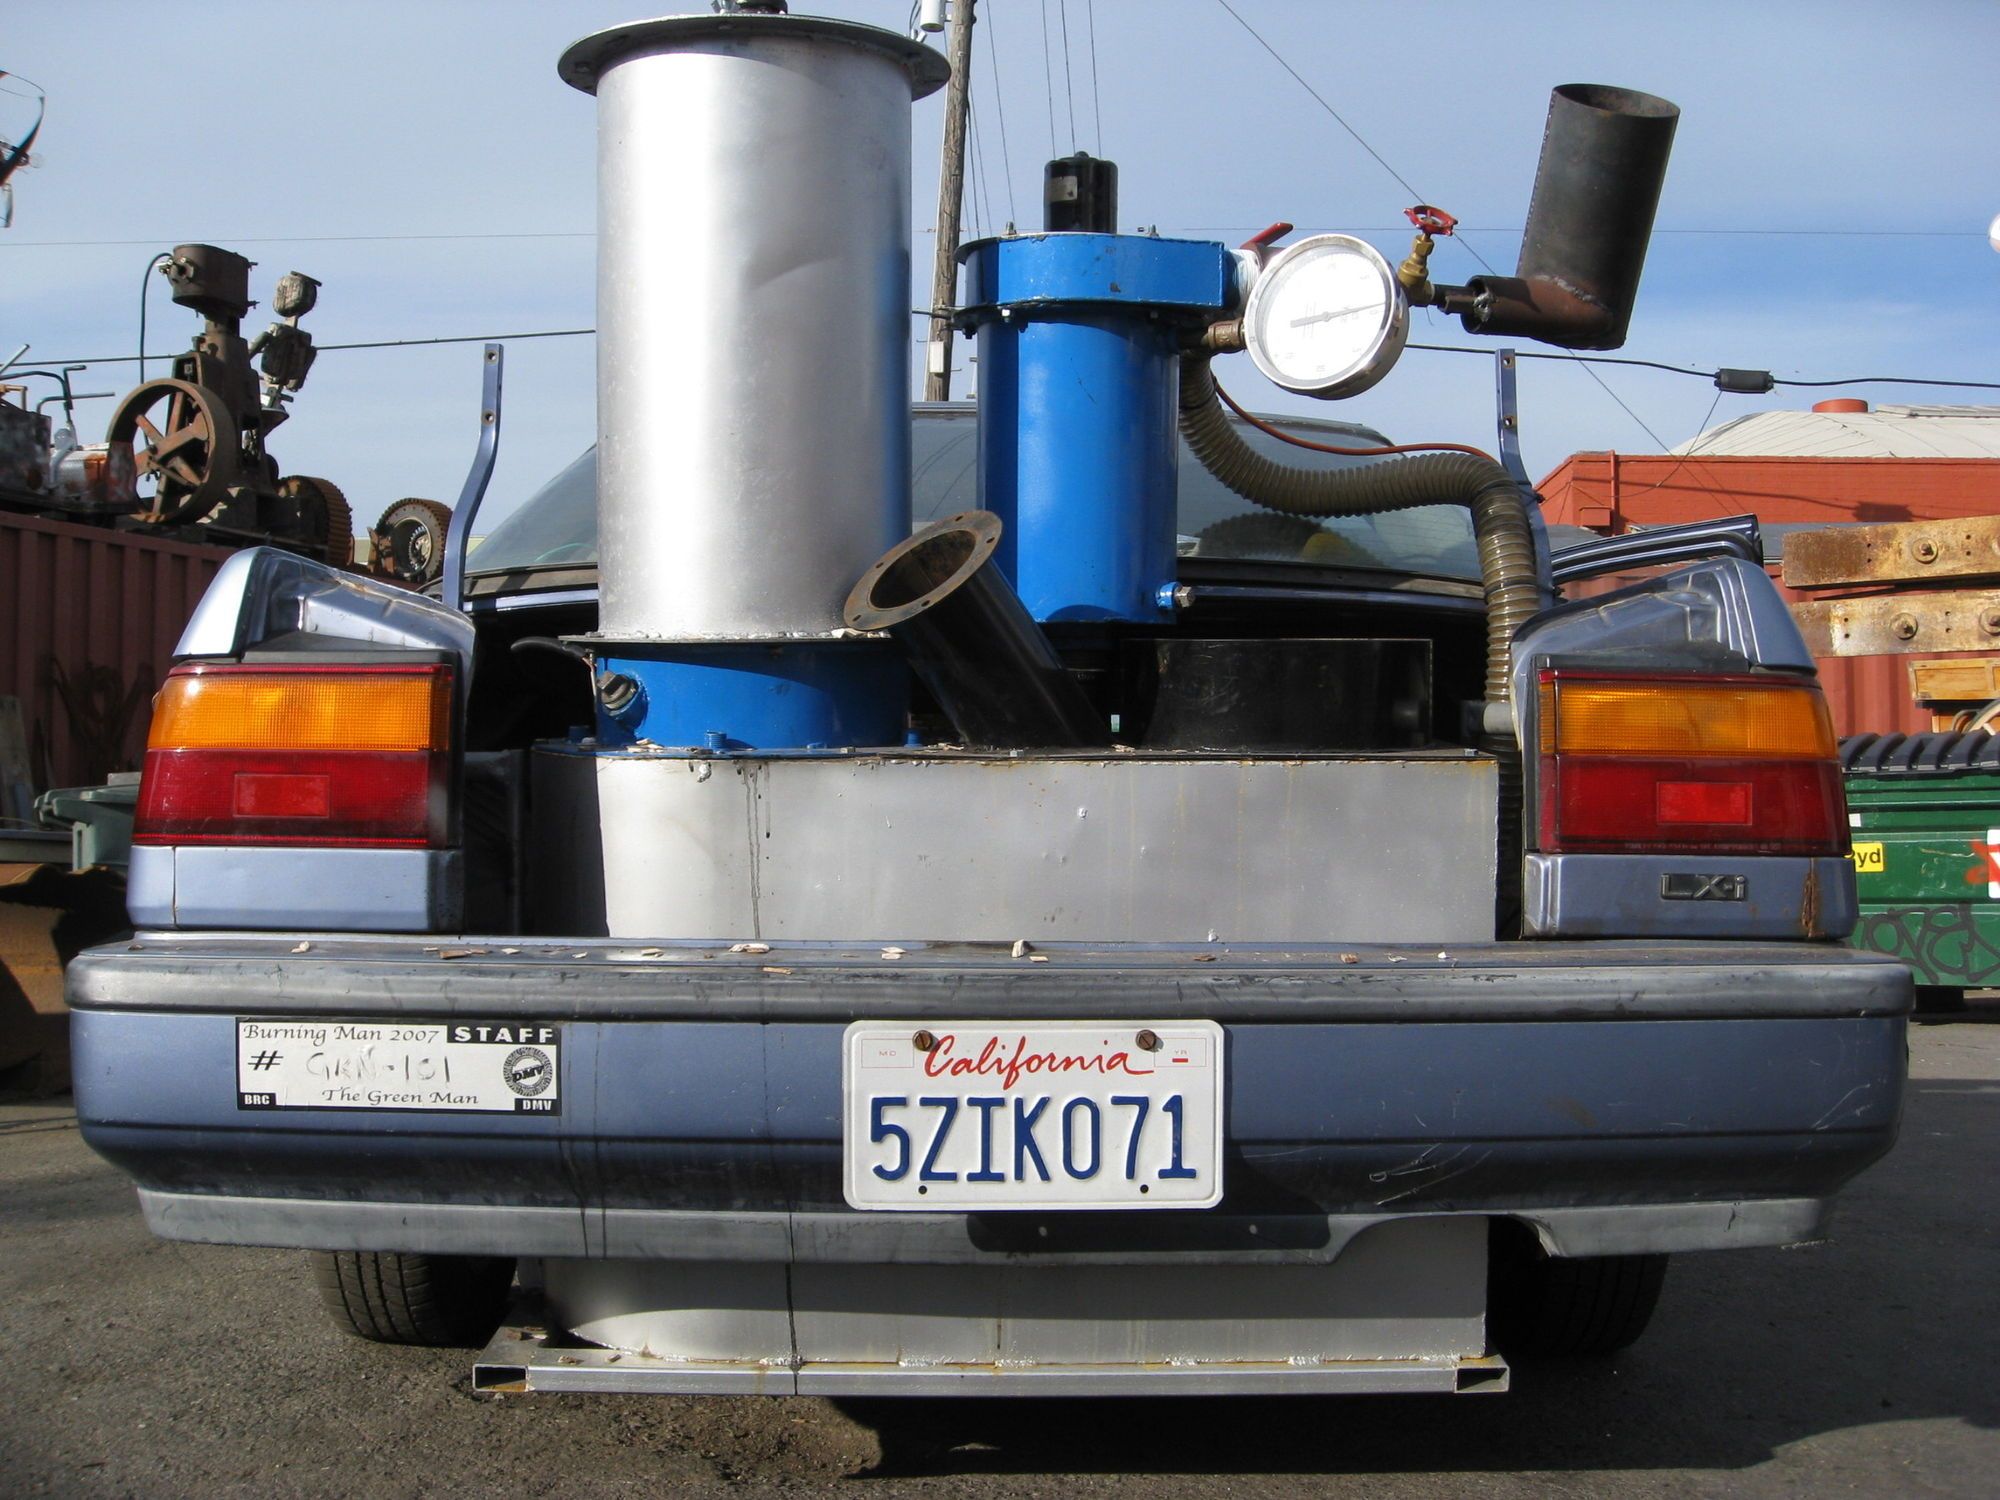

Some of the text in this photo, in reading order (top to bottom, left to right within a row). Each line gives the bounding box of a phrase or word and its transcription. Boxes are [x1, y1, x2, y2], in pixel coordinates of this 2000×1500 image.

[1660, 874, 1745, 899] LXi
[243, 1024, 440, 1047] Burning Man 2007
[454, 1026, 554, 1043] STAFF
[923, 1034, 1155, 1091] California
[512, 1064, 544, 1083] DMV
[244, 1094, 270, 1105] BRC
[322, 1088, 479, 1105] The Green Man
[522, 1099, 552, 1111] DMV
[870, 1094, 1197, 1182] 5ZIK071
